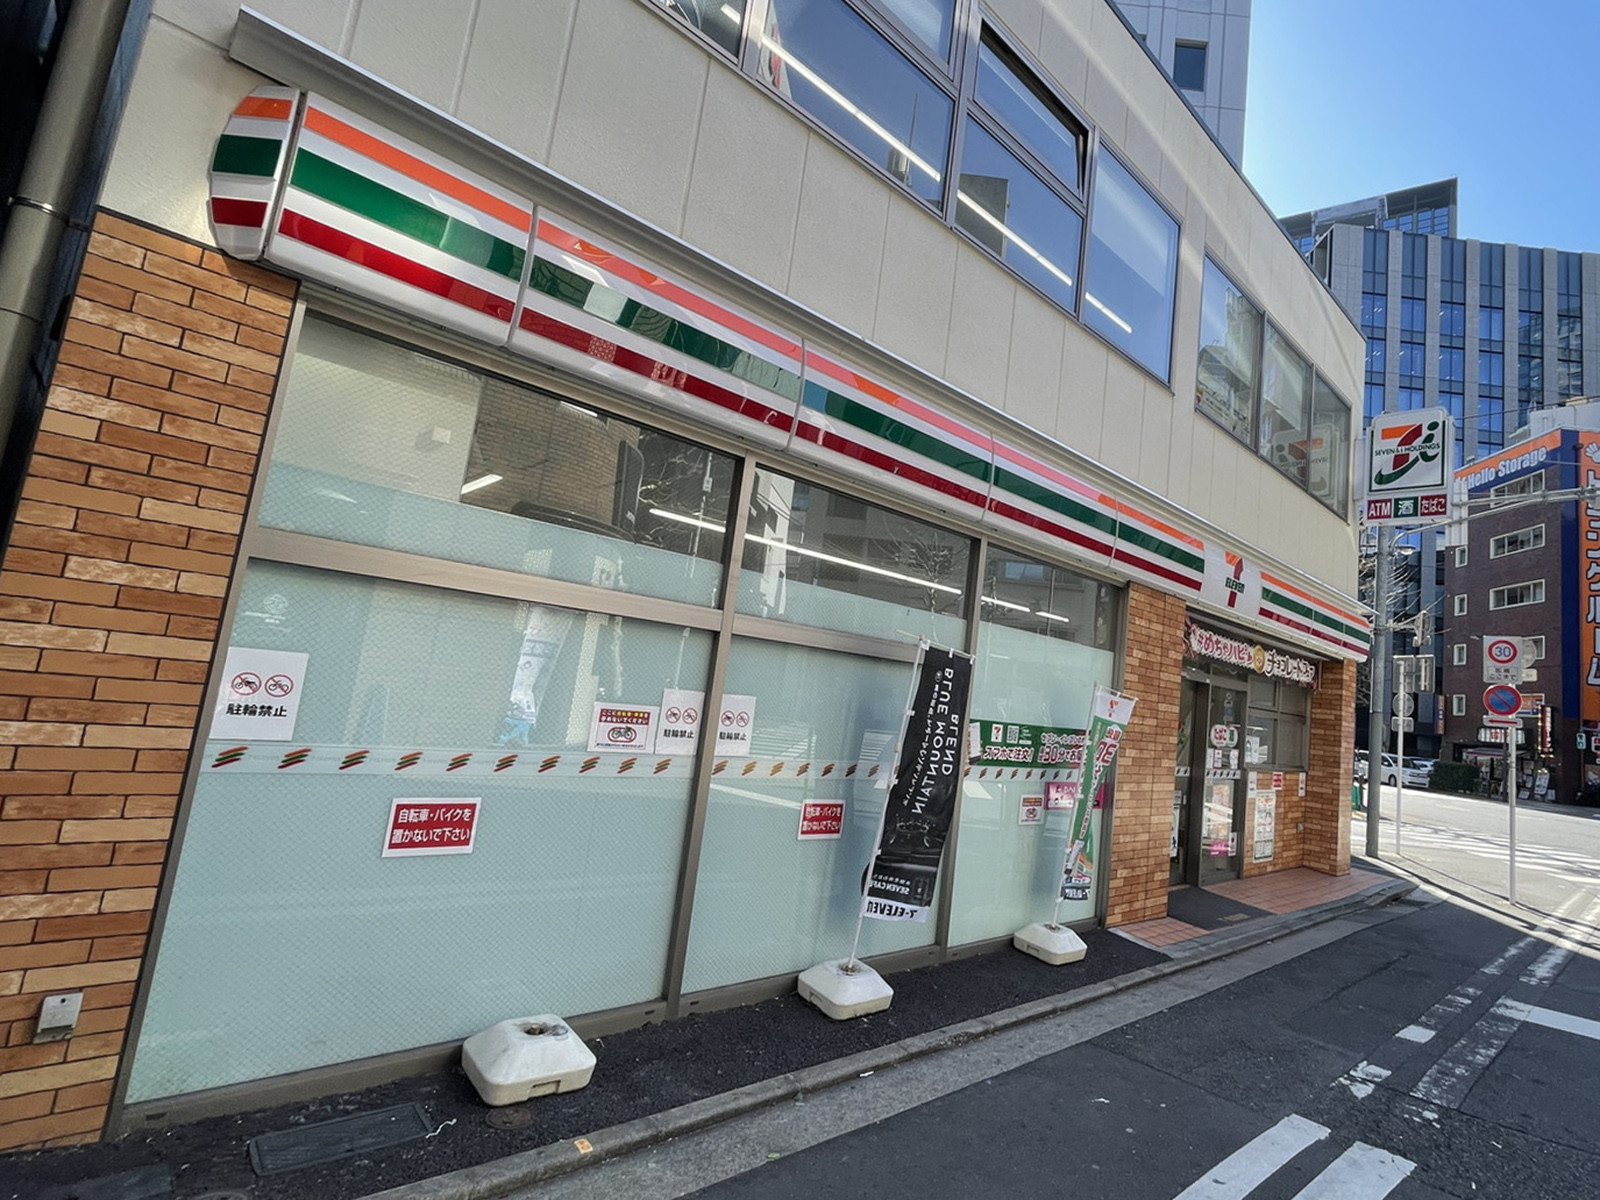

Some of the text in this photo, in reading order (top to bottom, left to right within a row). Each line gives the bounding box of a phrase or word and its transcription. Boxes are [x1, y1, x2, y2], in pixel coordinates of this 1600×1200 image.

[1374, 447, 1395, 457] SEVEN
[1403, 442, 1440, 453] HOLDINGS
[1467, 447, 1548, 489] Hello Storage
[1368, 502, 1391, 518] ATM
[1398, 501, 1414, 515] 酒
[1421, 498, 1446, 514] たばこ
[1494, 646, 1512, 658] 30
[226, 703, 288, 718] 駐輪禁止
[663, 728, 695, 739] 駐輪禁止
[719, 731, 747, 741] 駐輪禁止
[398, 808, 472, 824] 自転車・バイクを
[391, 827, 470, 844] 置かないで下さい
